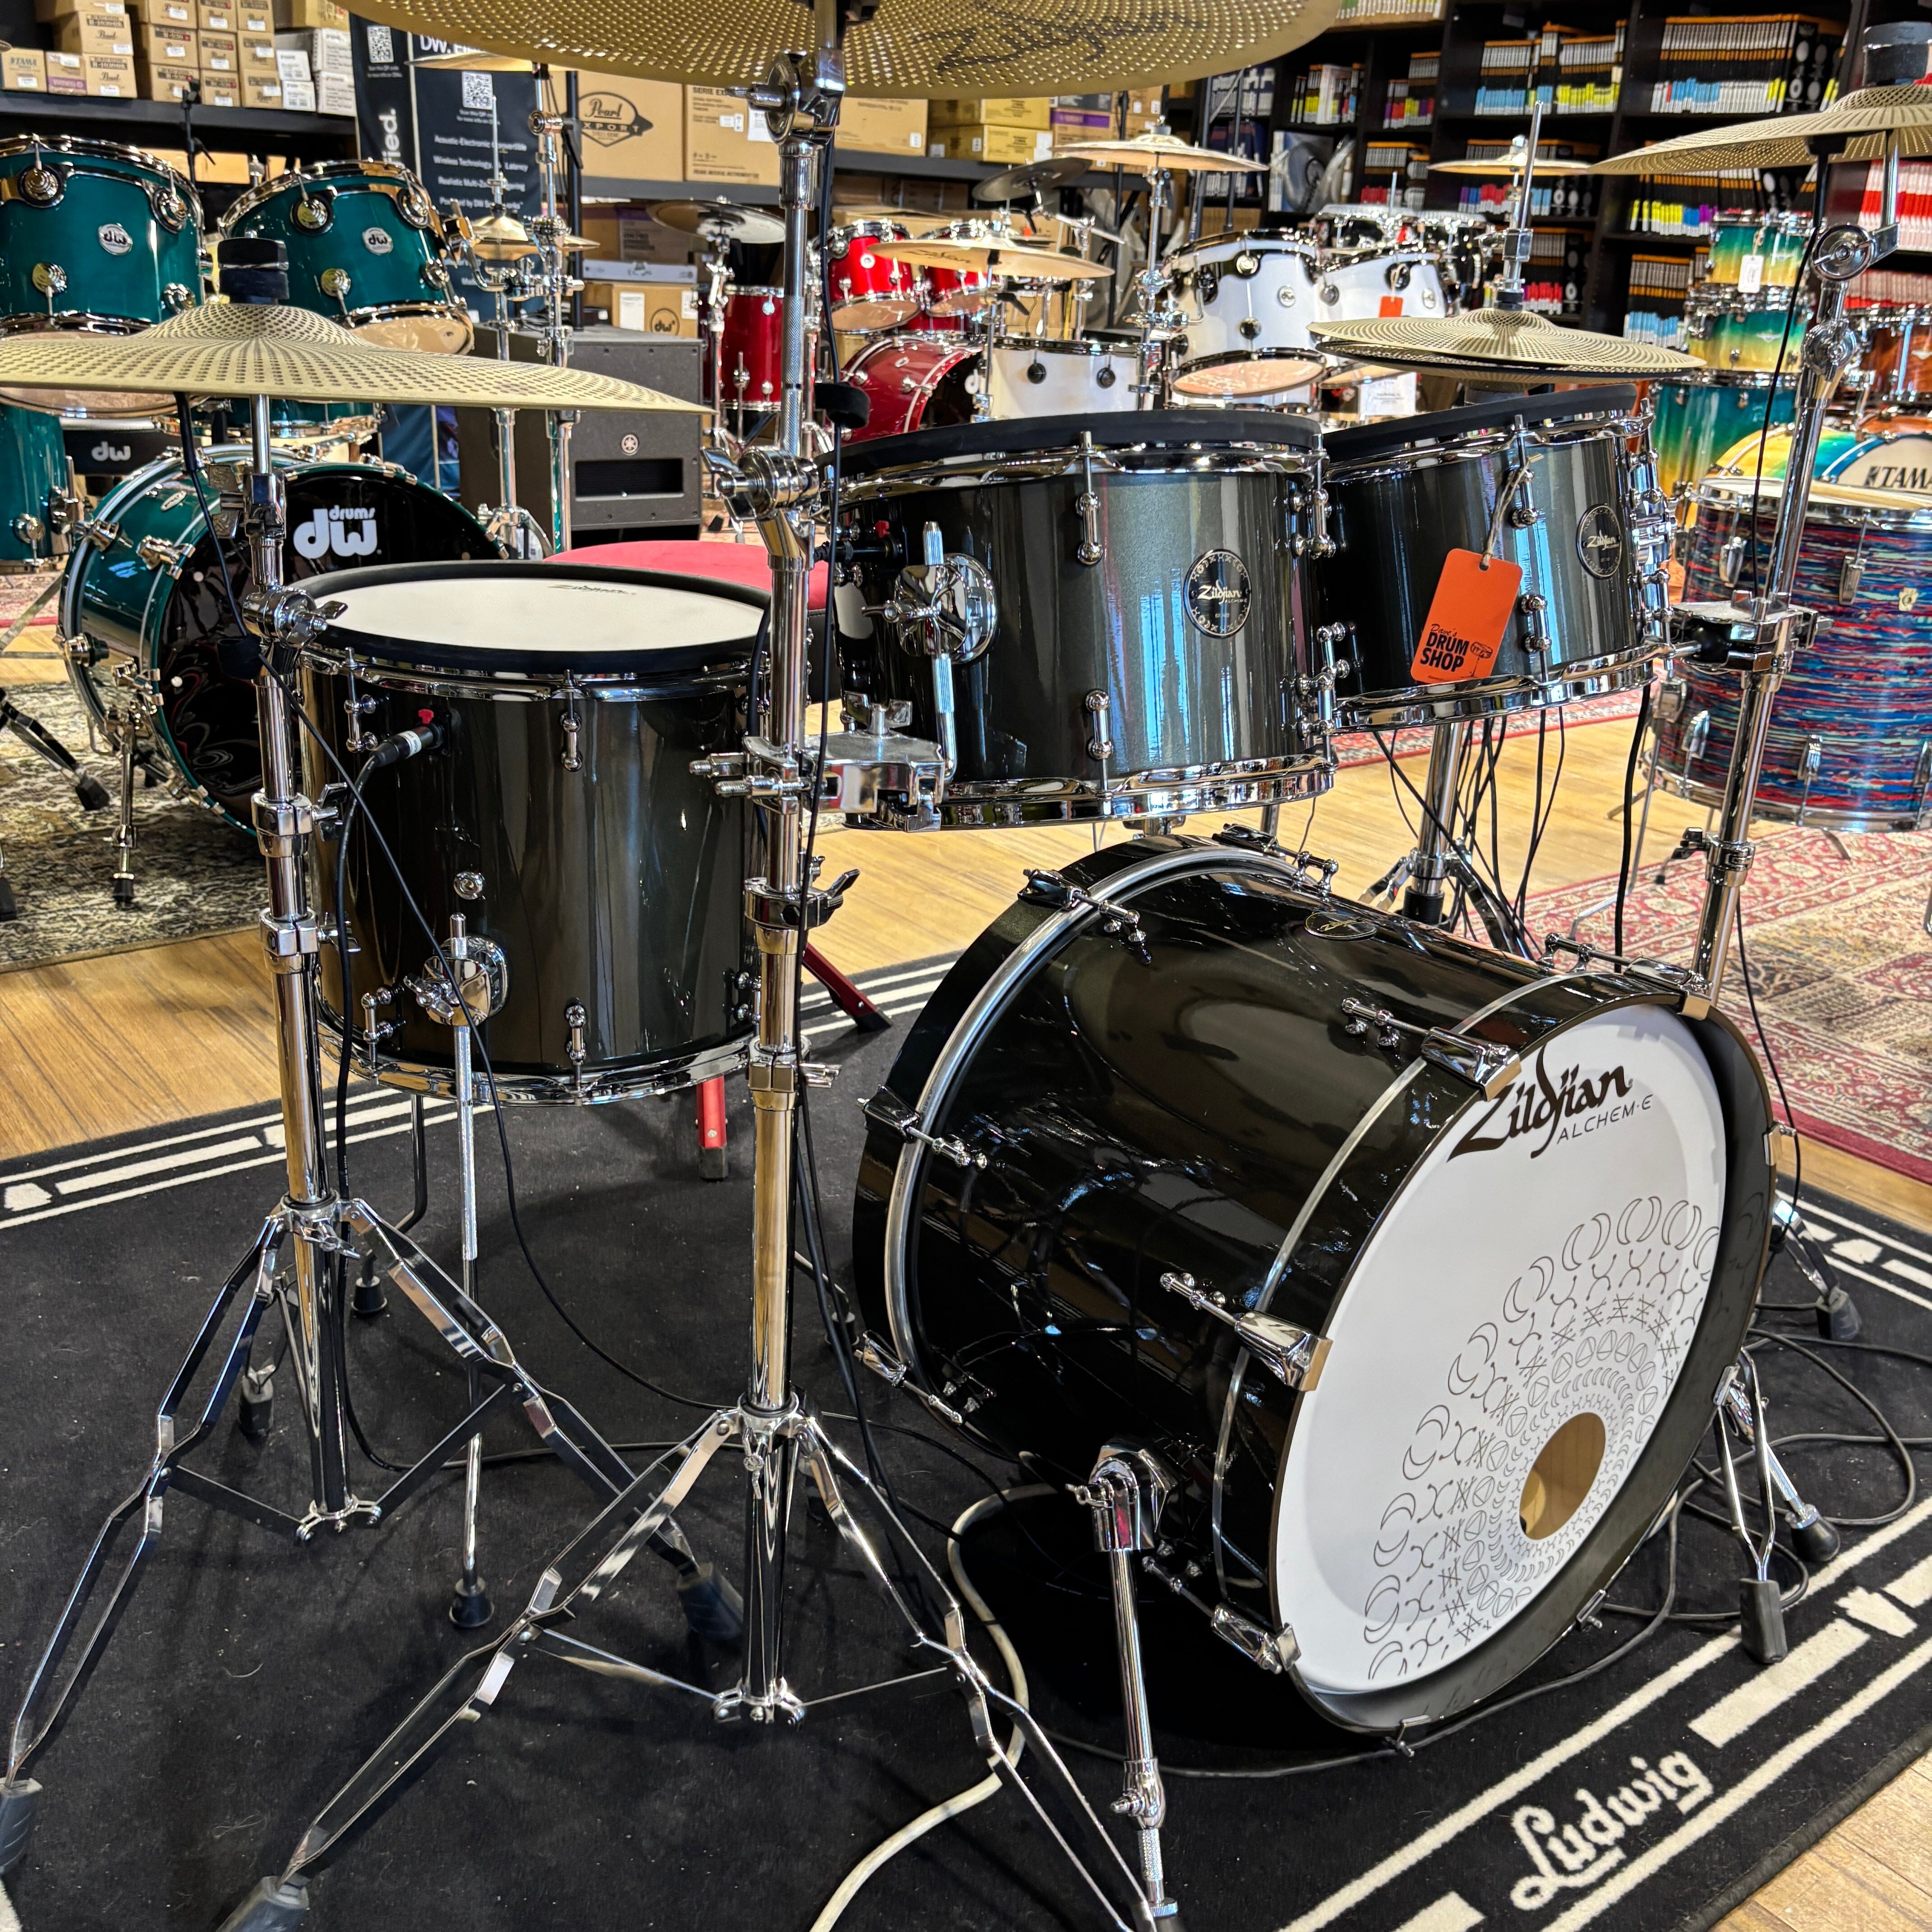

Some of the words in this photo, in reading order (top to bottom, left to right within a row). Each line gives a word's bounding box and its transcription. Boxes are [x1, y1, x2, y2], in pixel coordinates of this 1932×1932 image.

[585, 98, 623, 119] Pearl
[583, 122, 639, 133] XPORT
[368, 234, 388, 245] dw
[654, 320, 672, 332] dw
[91, 441, 131, 461] dw
[329, 505, 376, 520] drums
[293, 508, 378, 559] dw
[1196, 580, 1241, 605] Zildjian
[1431, 623, 1458, 637] Dave's
[1426, 631, 1470, 657] DRUM
[1420, 647, 1464, 672] SHOP
[1446, 1042, 1633, 1163] Zildjian
[1510, 1751, 1714, 1911] Ludwig
